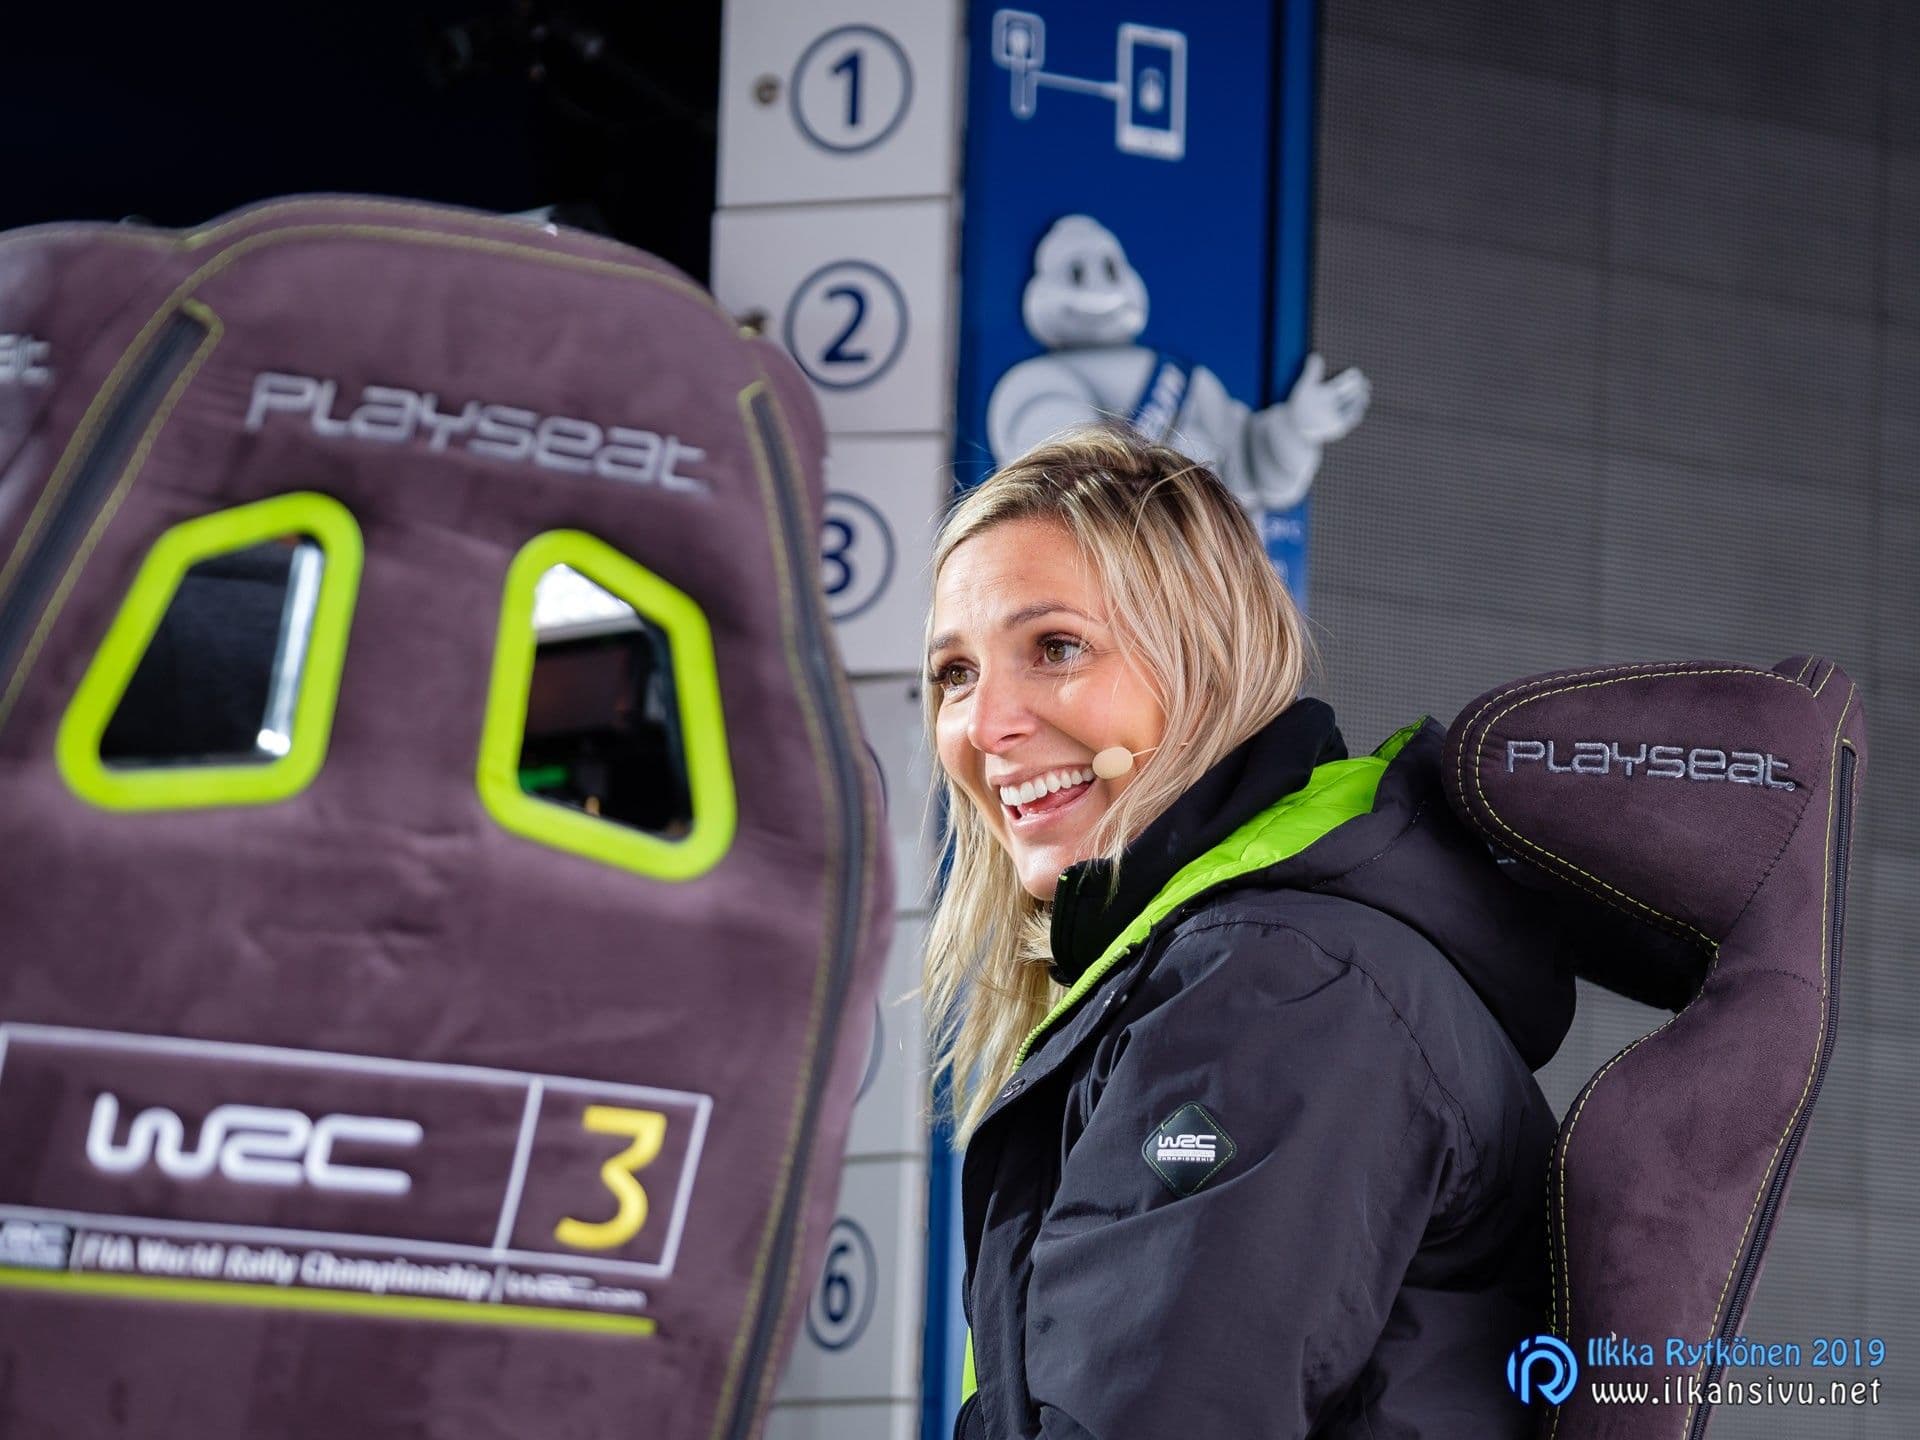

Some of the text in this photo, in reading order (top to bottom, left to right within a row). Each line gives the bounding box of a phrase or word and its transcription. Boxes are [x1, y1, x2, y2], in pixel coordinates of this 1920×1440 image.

[829, 50, 864, 127] 1
[823, 286, 868, 366] 2
[821, 517, 855, 596] 3
[86, 1092, 668, 1250] WRC 3
[1158, 1134, 1217, 1149] WRC
[137, 1236, 224, 1278] World
[224, 1245, 298, 1287] Rally
[822, 1244, 851, 1323] 6
